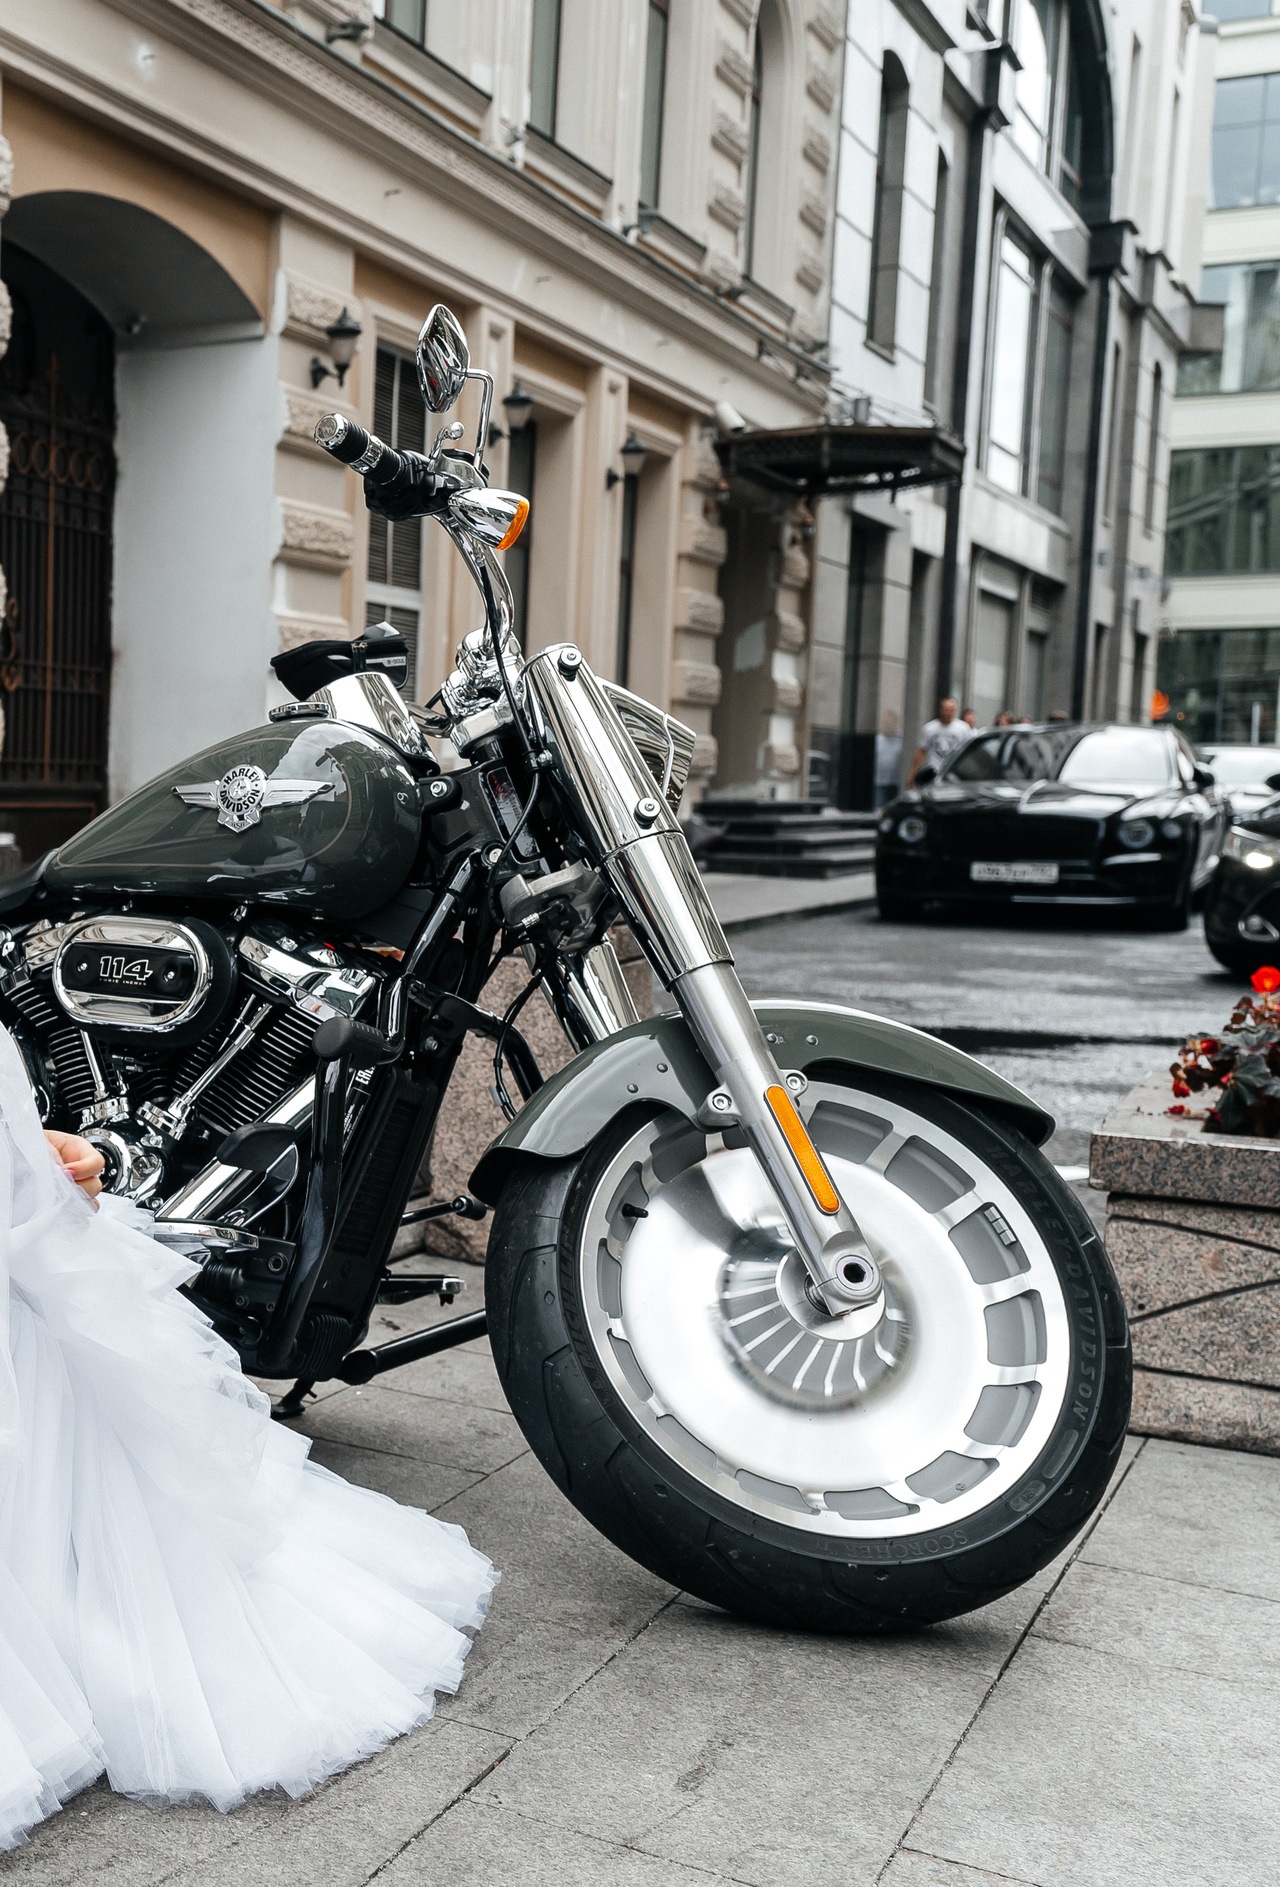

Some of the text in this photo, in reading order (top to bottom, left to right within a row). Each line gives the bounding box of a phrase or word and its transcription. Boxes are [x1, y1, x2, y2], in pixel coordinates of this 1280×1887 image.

[223, 767, 261, 786] HARLEY
[219, 789, 261, 813] DAVIDSON
[100, 955, 153, 981] 114
[846, 1529, 969, 1559] SCORCHER
